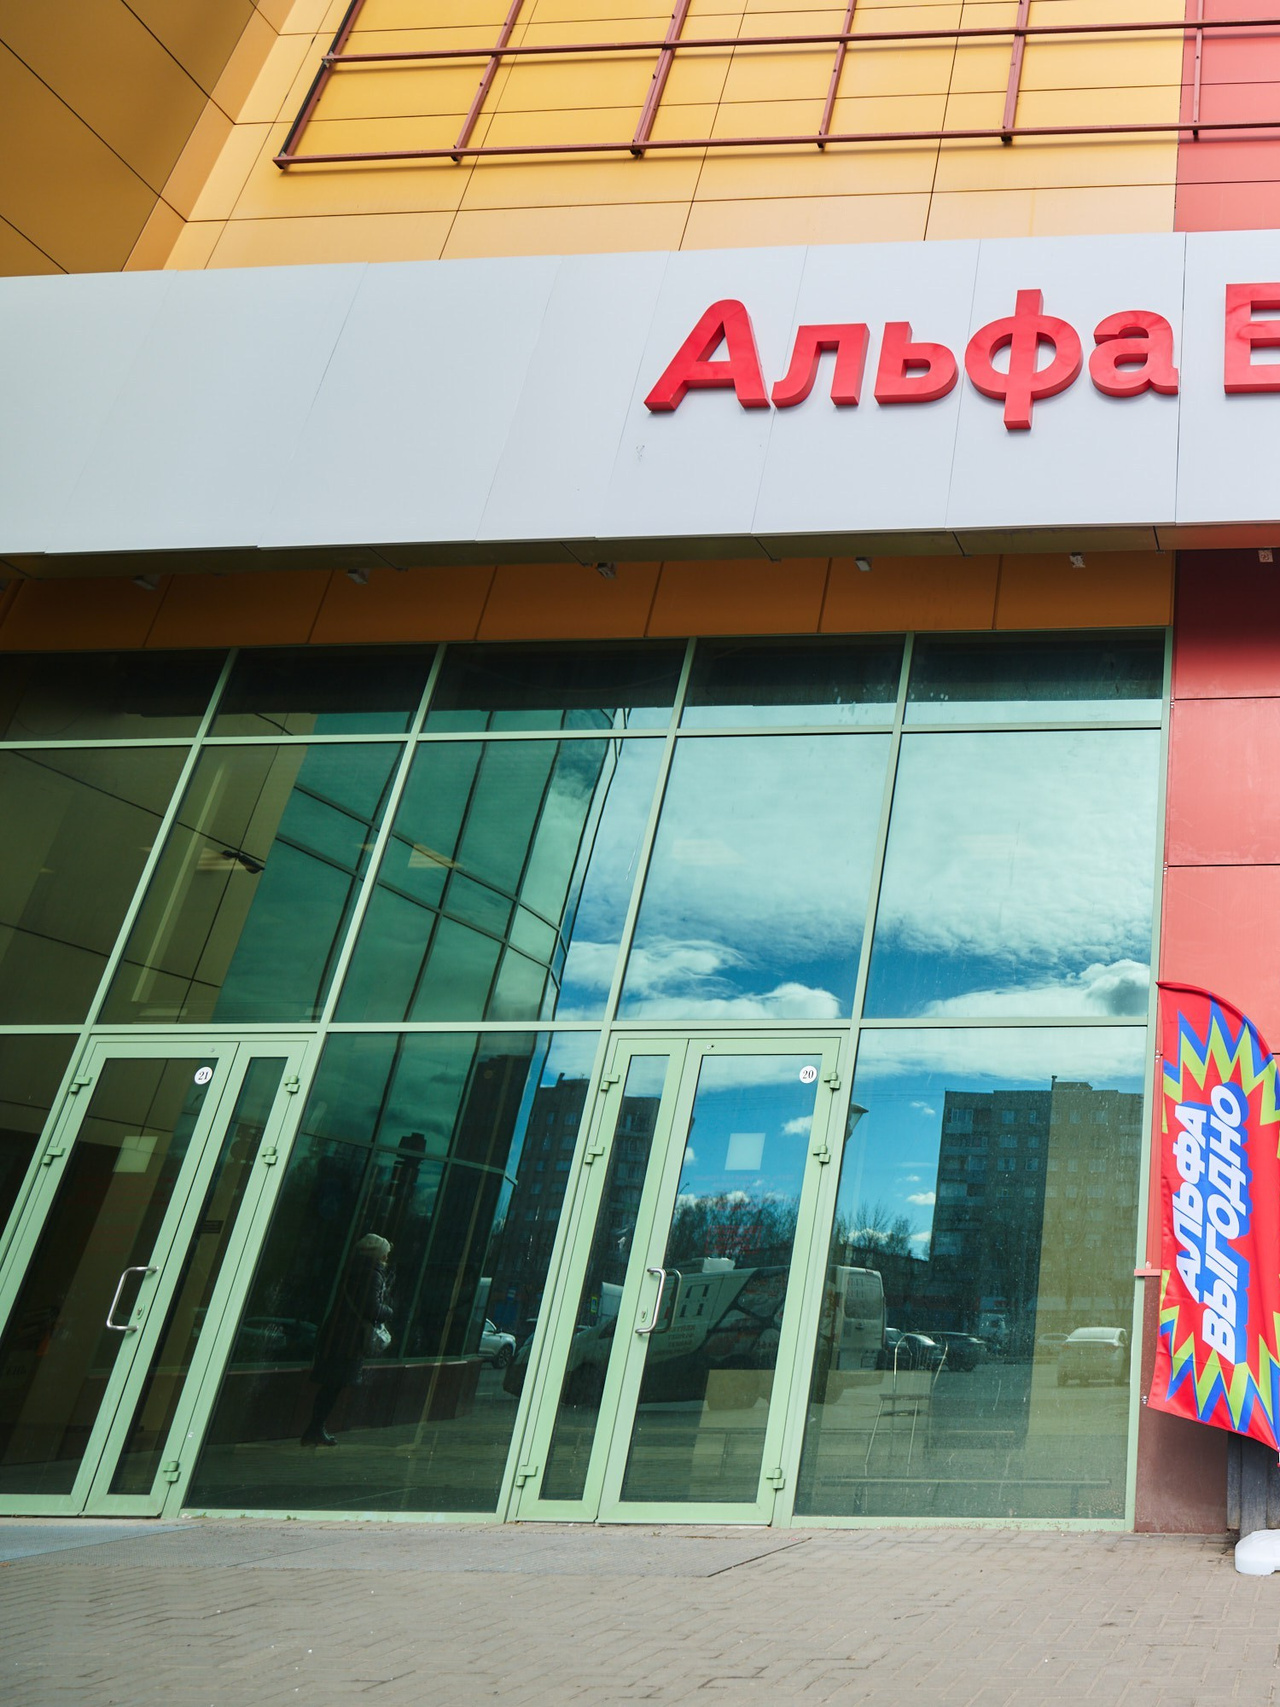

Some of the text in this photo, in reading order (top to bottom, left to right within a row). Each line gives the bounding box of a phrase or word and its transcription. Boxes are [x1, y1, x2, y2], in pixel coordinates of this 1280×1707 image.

[643, 288, 1179, 430] Альфа
[1172, 1104, 1207, 1304] АЛЬФА
[1202, 1085, 1246, 1365] ВЫГОДНО
